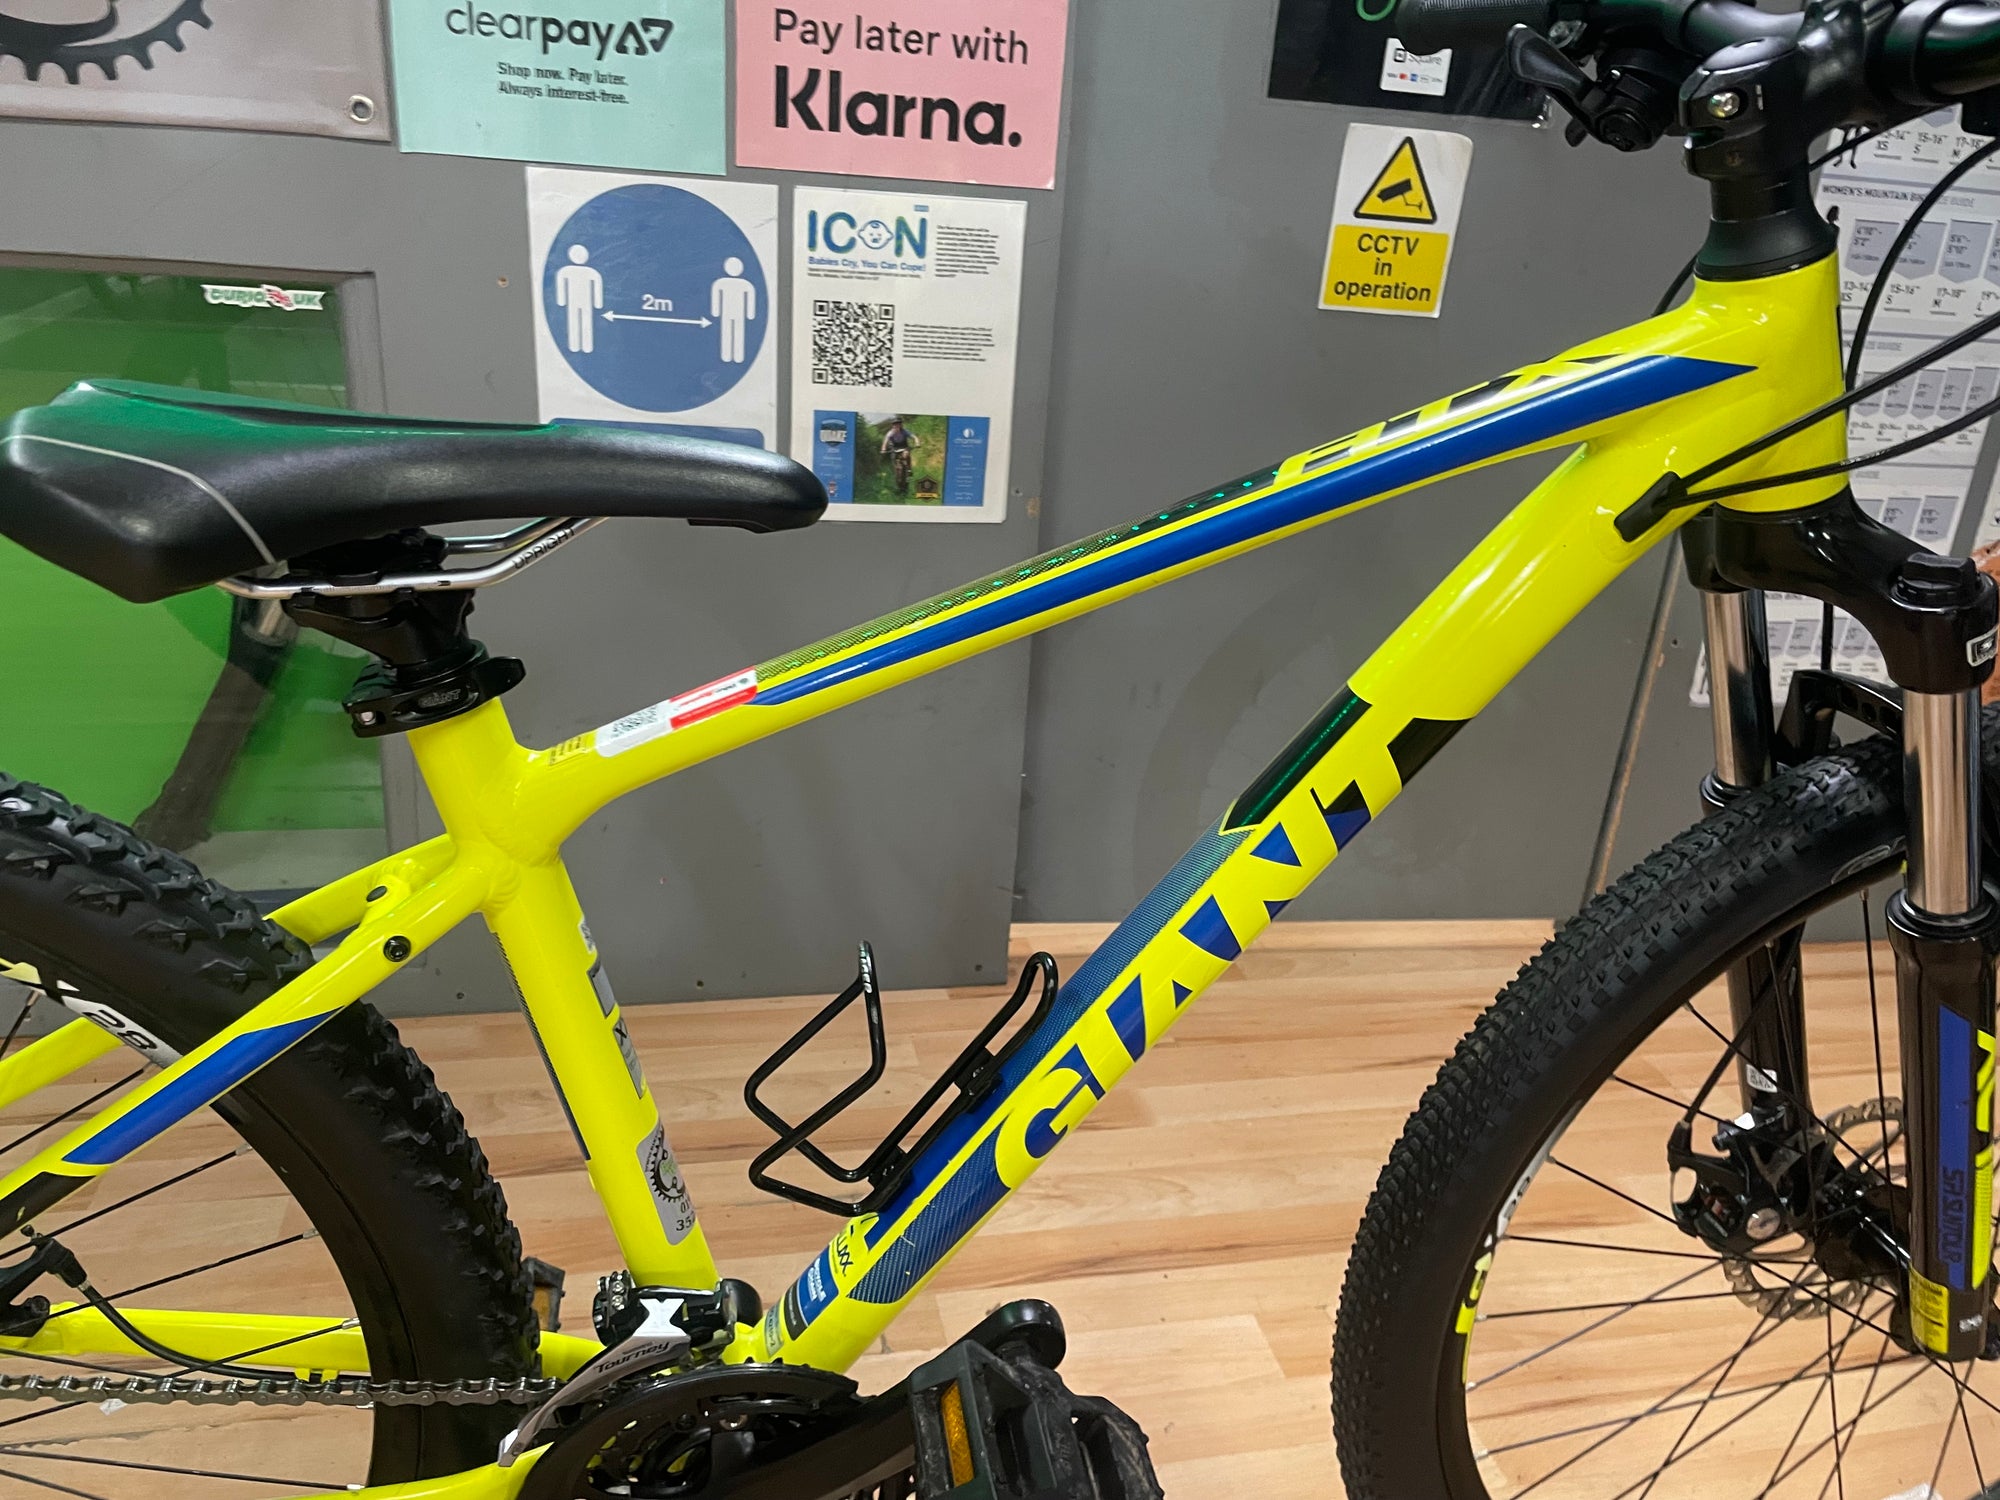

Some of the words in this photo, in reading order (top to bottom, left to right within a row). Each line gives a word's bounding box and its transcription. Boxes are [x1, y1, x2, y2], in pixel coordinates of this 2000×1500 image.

[446, 0, 615, 60] clearpay
[774, 8, 843, 54] Pay
[855, 15, 941, 56] later
[952, 26, 1028, 65] with
[497, 62, 529, 78] Shop
[569, 68, 592, 83] Pay
[595, 70, 629, 86] later.
[499, 81, 542, 98] Always
[775, 65, 1022, 147] Klarna.
[1823, 185, 1863, 197] WOMEN'S
[1865, 188, 1909, 201] MOUNTAIN
[1358, 233, 1419, 256] CCTV
[808, 256, 839, 266] Babies
[861, 259, 878, 269] You
[880, 261, 897, 269] Can
[1374, 258, 1392, 276] in
[642, 294, 673, 311] 2m
[1334, 281, 1431, 302] operation
[594, 1341, 670, 1374] Tourney
